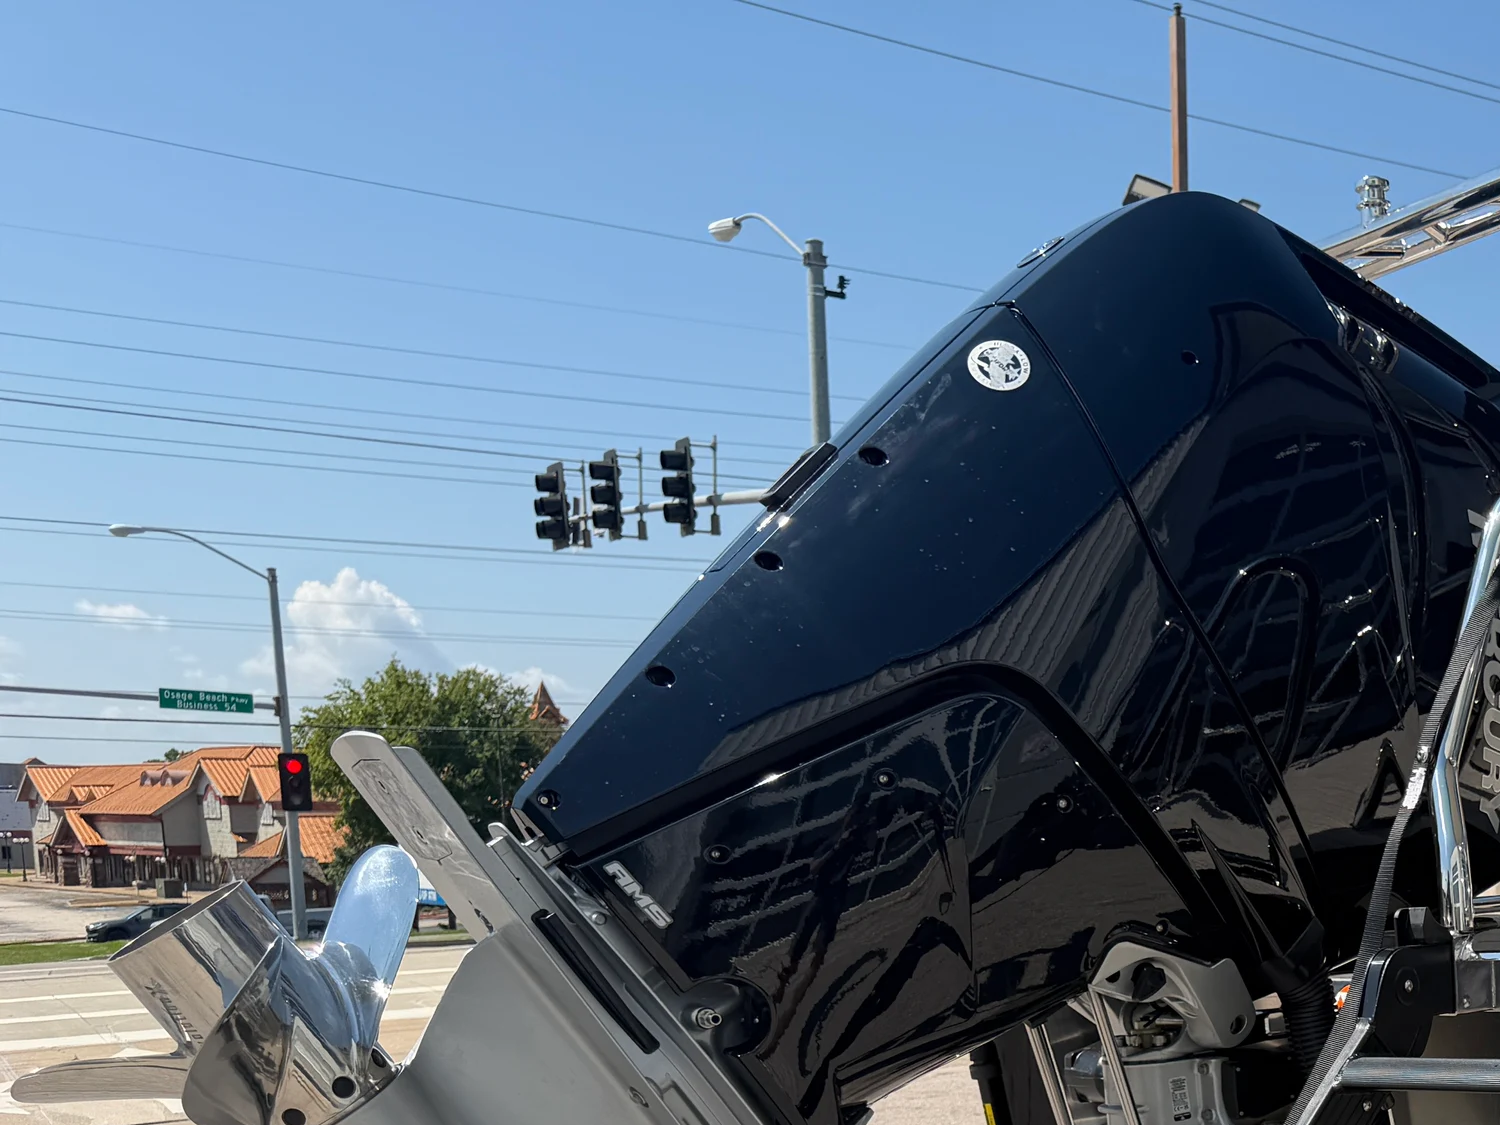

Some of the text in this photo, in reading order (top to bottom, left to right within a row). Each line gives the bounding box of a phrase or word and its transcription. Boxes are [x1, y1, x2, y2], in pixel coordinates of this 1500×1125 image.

[163, 690, 194, 701] Osage
[199, 692, 228, 703] Beach
[176, 699, 237, 712] Business 54
[604, 862, 672, 928] AMS
